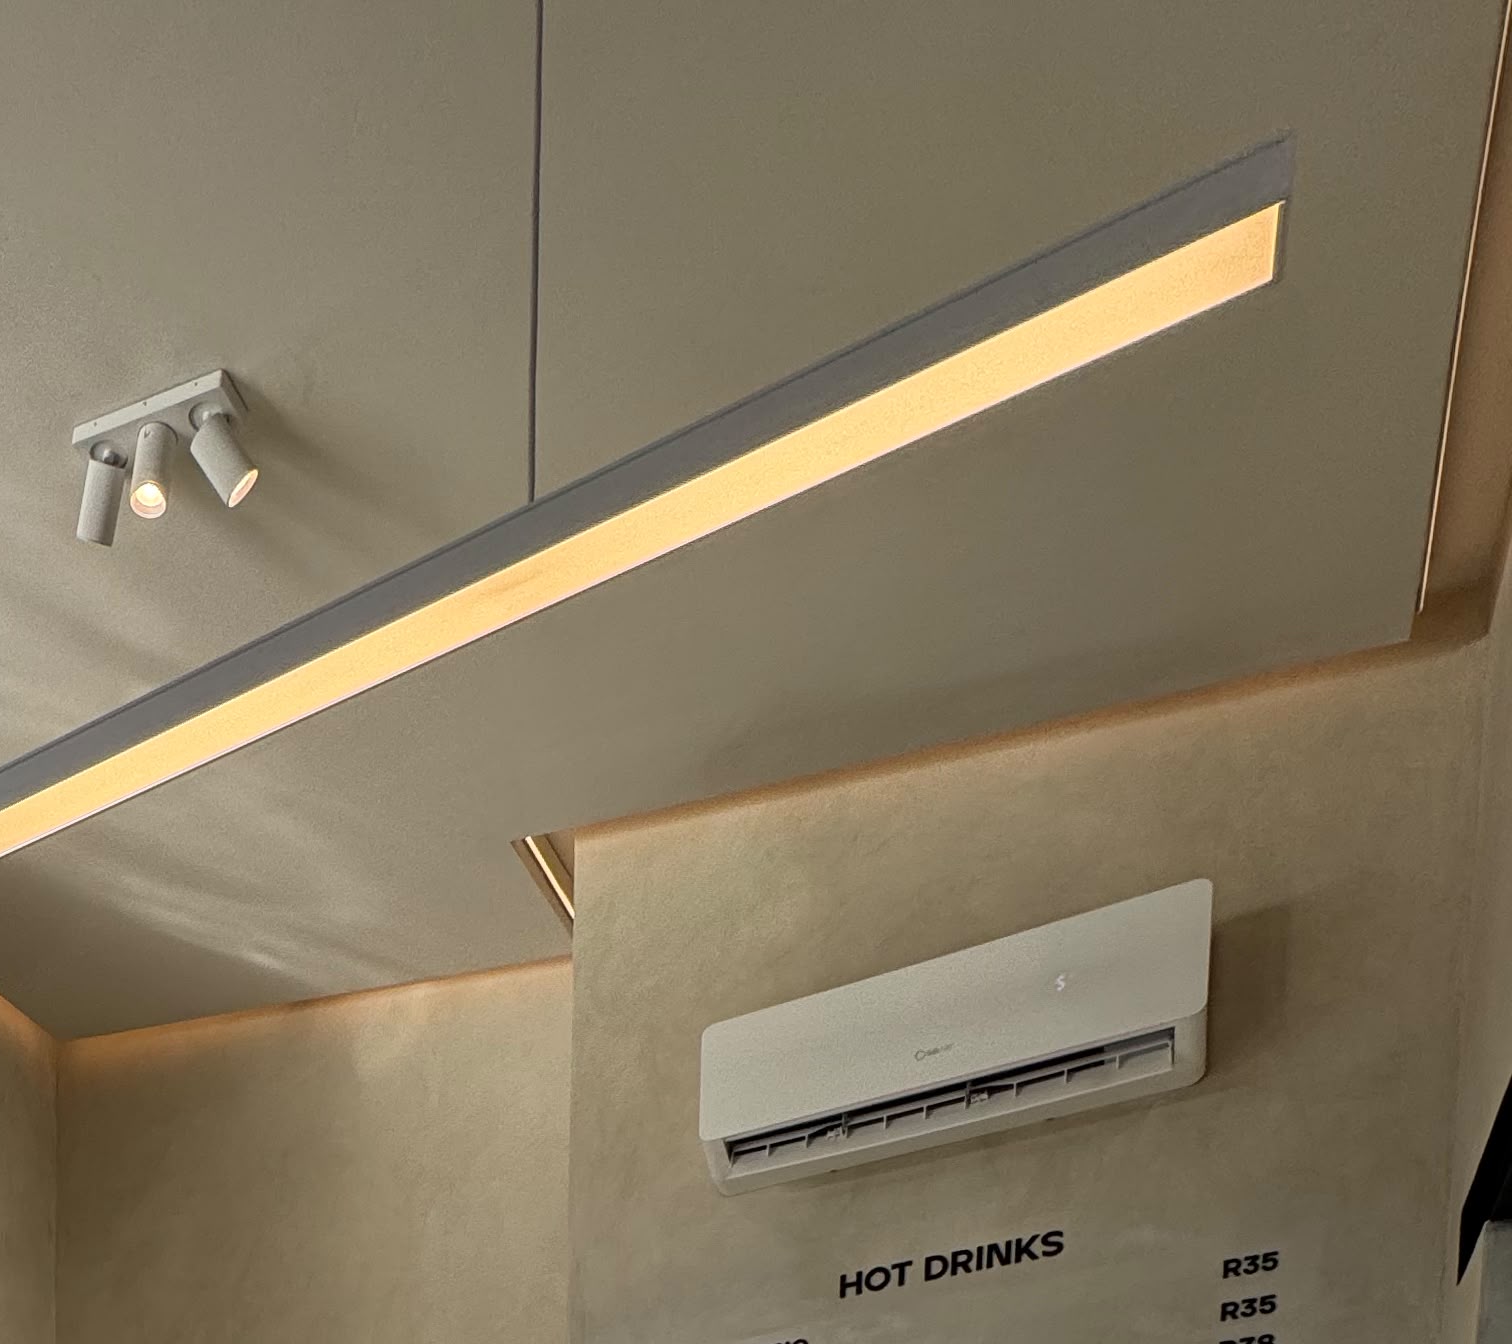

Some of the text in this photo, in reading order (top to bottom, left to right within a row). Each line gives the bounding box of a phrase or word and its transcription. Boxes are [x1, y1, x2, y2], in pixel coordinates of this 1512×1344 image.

[839, 1230, 1065, 1300] HOT DRINKS
[1222, 1250, 1280, 1280] R35
[1219, 1293, 1277, 1322] R35
